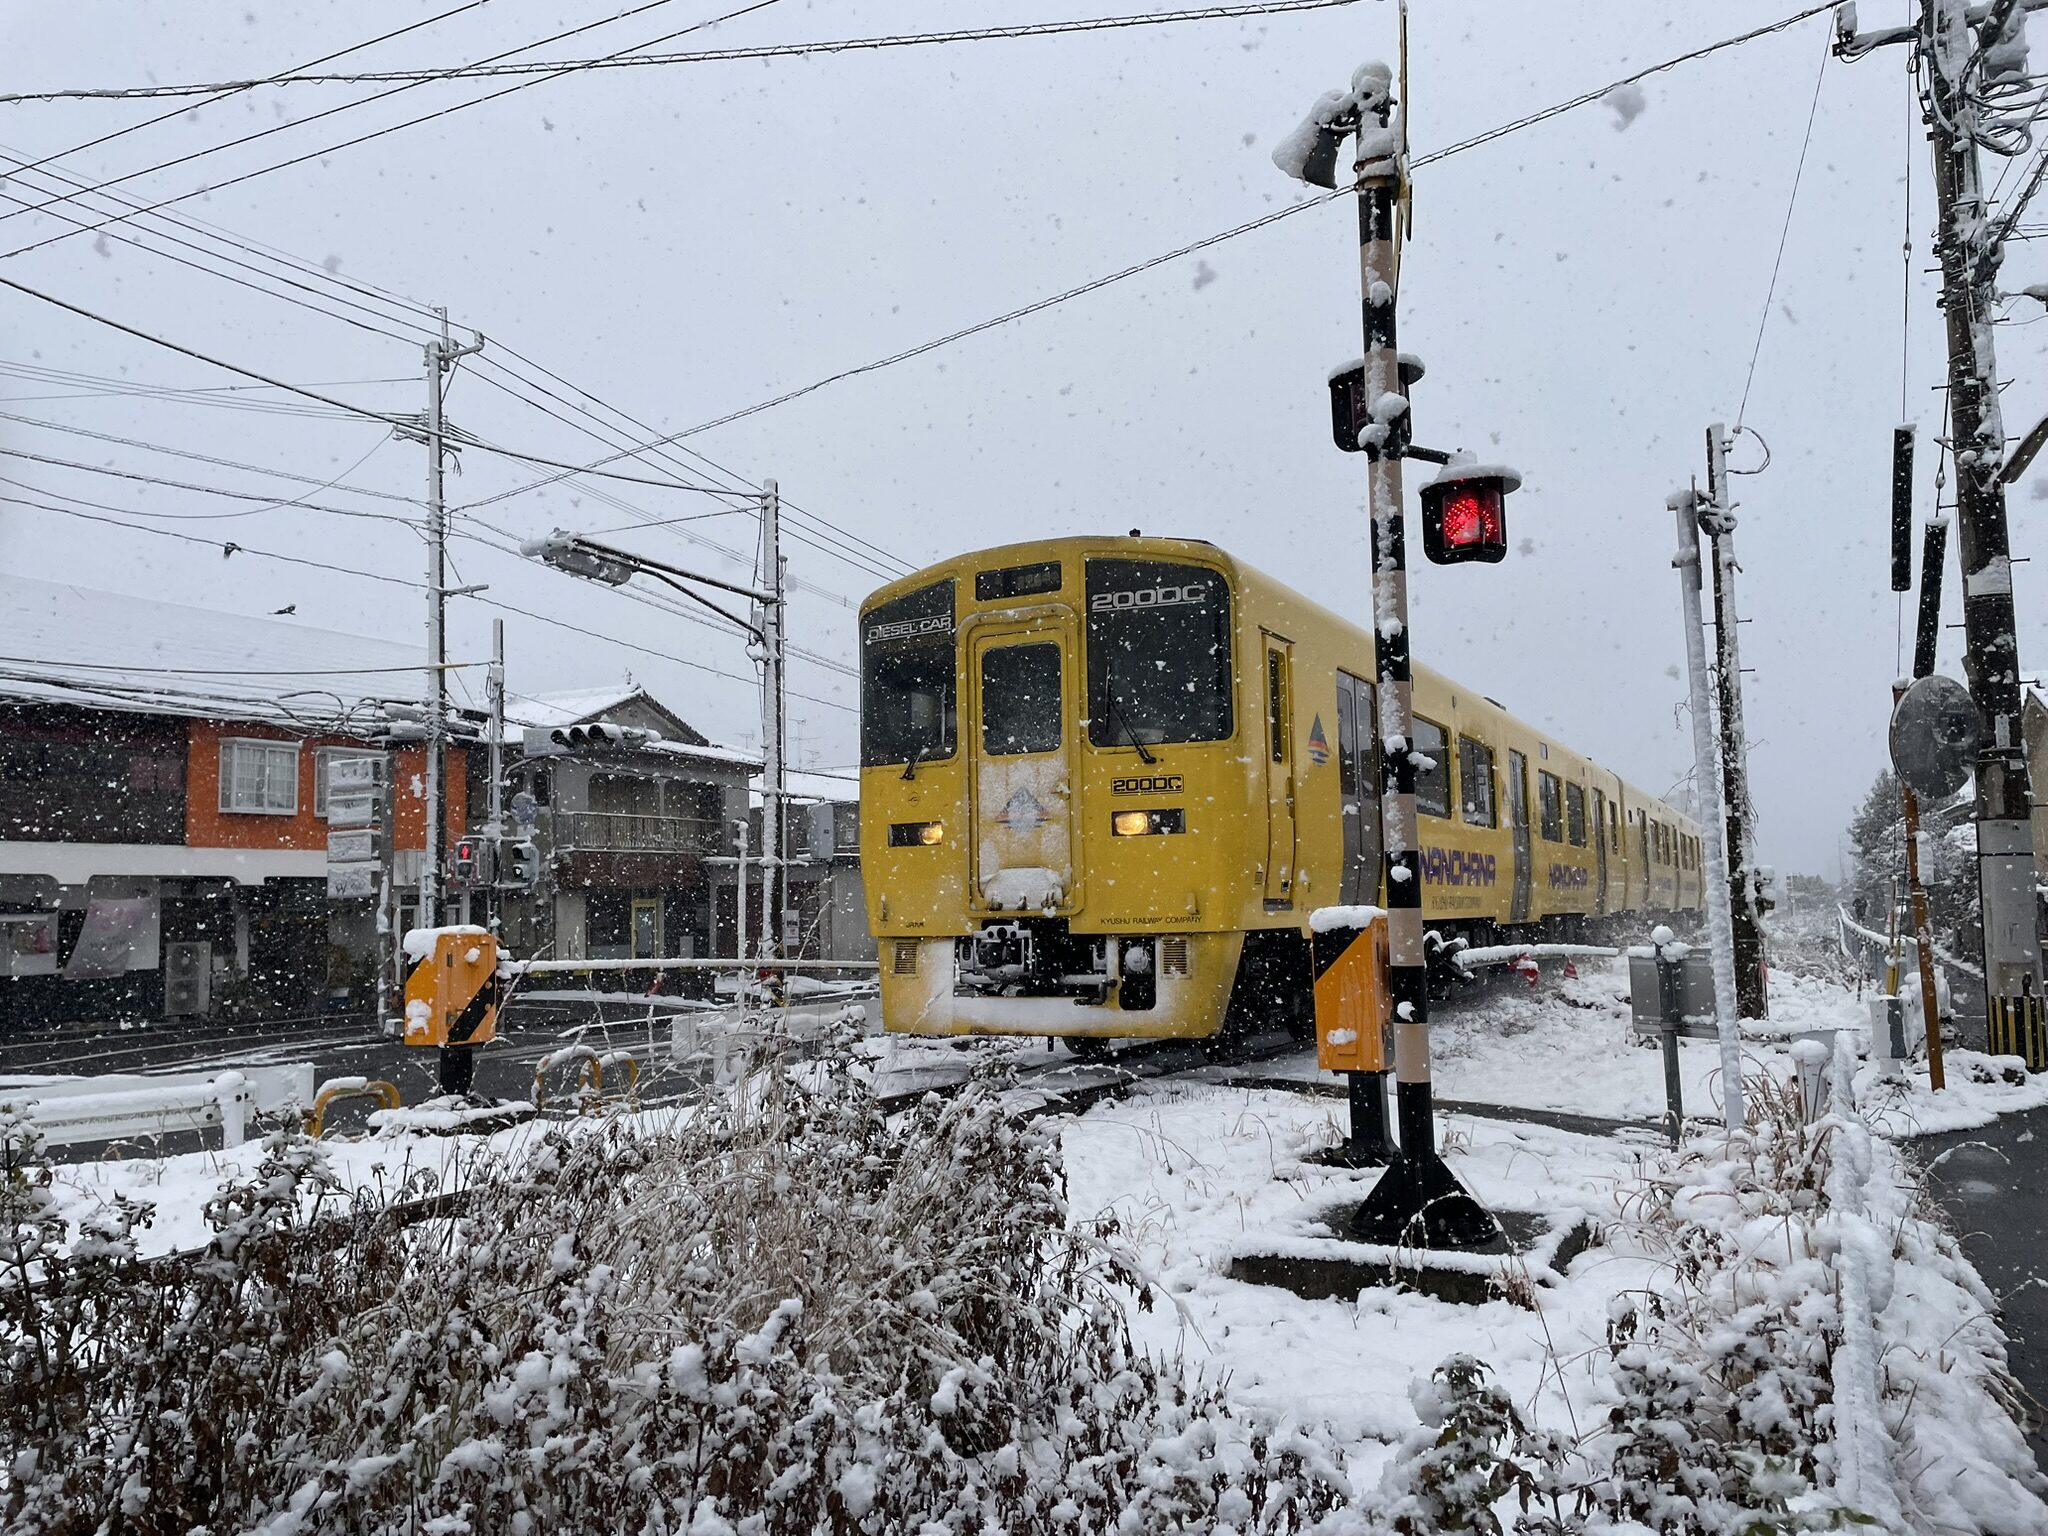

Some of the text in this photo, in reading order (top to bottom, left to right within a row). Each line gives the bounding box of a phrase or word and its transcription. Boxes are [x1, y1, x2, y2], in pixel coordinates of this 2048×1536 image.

[868, 616, 952, 640] DIESEL CAR
[1165, 916, 1202, 924] COMPANY
